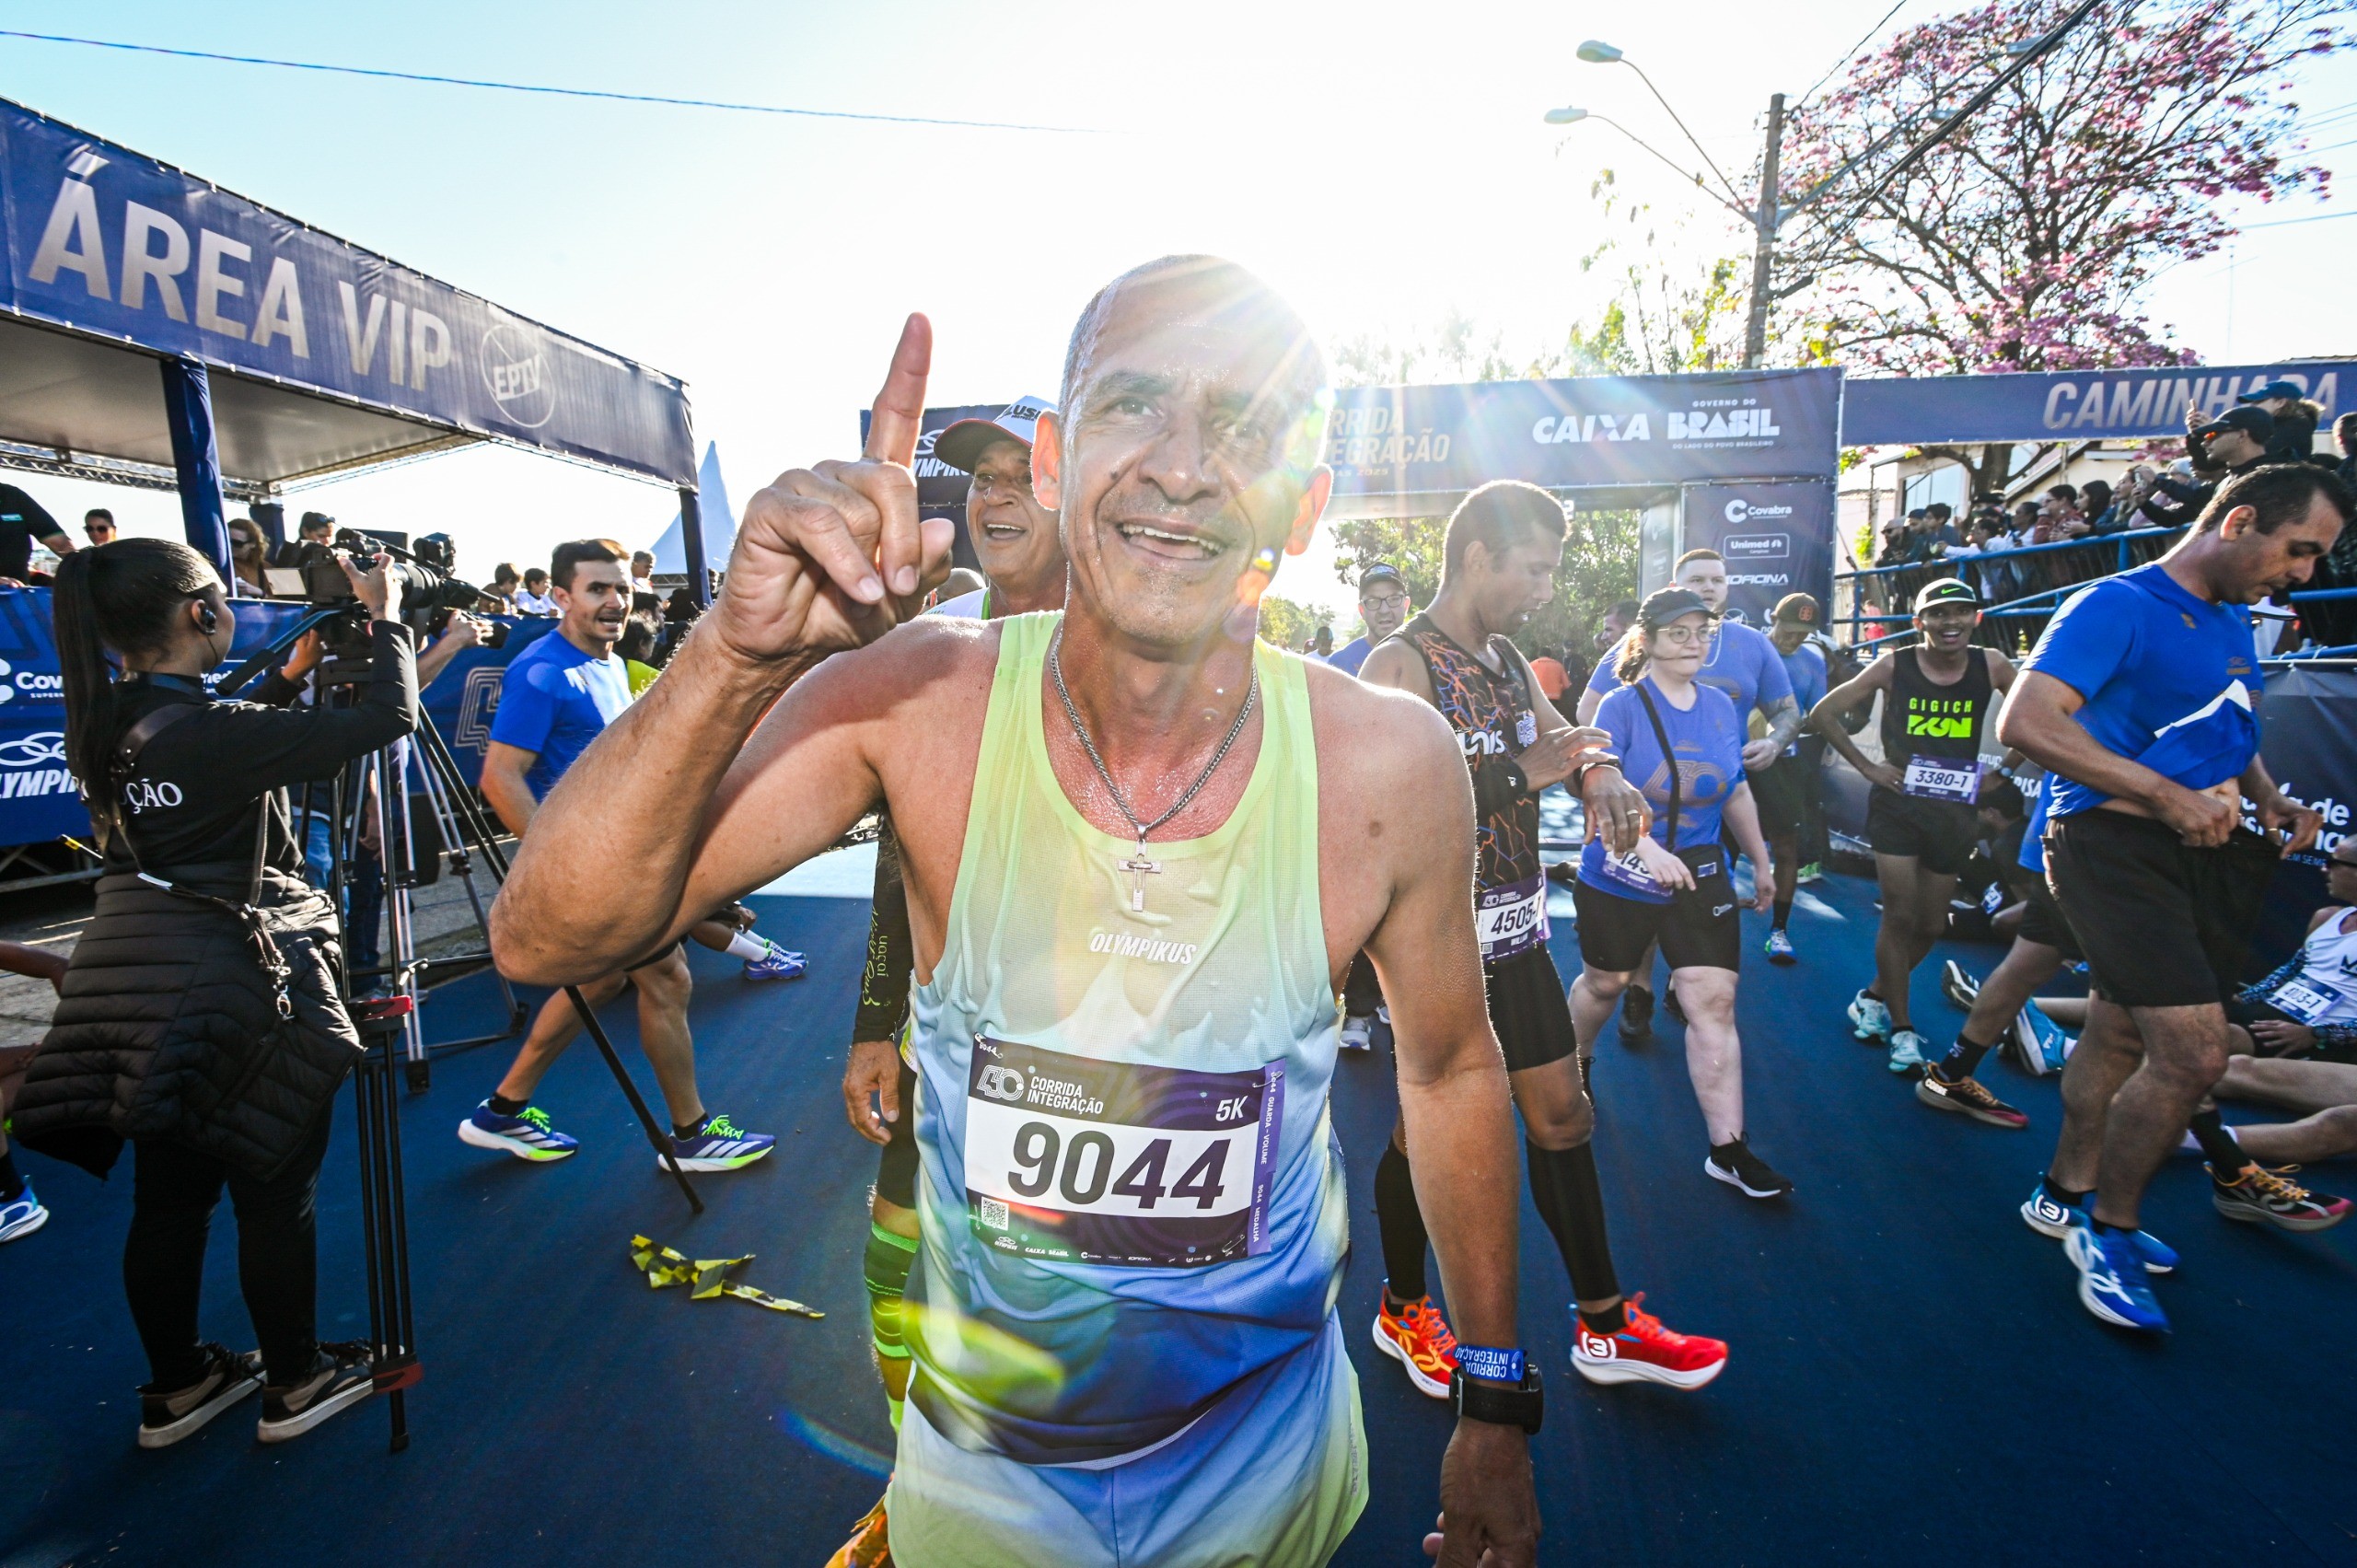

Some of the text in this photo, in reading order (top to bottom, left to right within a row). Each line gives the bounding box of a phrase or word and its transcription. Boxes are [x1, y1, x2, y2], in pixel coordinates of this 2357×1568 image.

[28, 152, 450, 391] ÁREA VIP
[493, 354, 541, 401] EPTV
[1692, 400, 1738, 408] GOVERNO
[1329, 407, 1404, 437] RRIDA
[1532, 413, 1651, 444] CAIXA
[1667, 409, 1781, 439] BRASIL
[1747, 505, 1793, 516] Covabra
[1731, 540, 1770, 550] Unimed
[1909, 697, 1973, 714] GIGICH
[1915, 770, 1968, 788] 3380-1
[1491, 896, 1541, 935] 4505-1
[1090, 933, 1197, 965] OLYMPIKUS
[1030, 1075, 1083, 1098] CORRIDA
[1027, 1089, 1104, 1115] INTEGRAÇÃO
[1215, 1095, 1248, 1121] 5K
[1007, 1121, 1232, 1210] 9044
[1253, 1184, 1264, 1243] 9044 MEDALHA
[1025, 1247, 1046, 1255] CAIXA
[1455, 1345, 1509, 1365] INTEGRAÇÃO
[1465, 1361, 1508, 1378] CORRIDA
